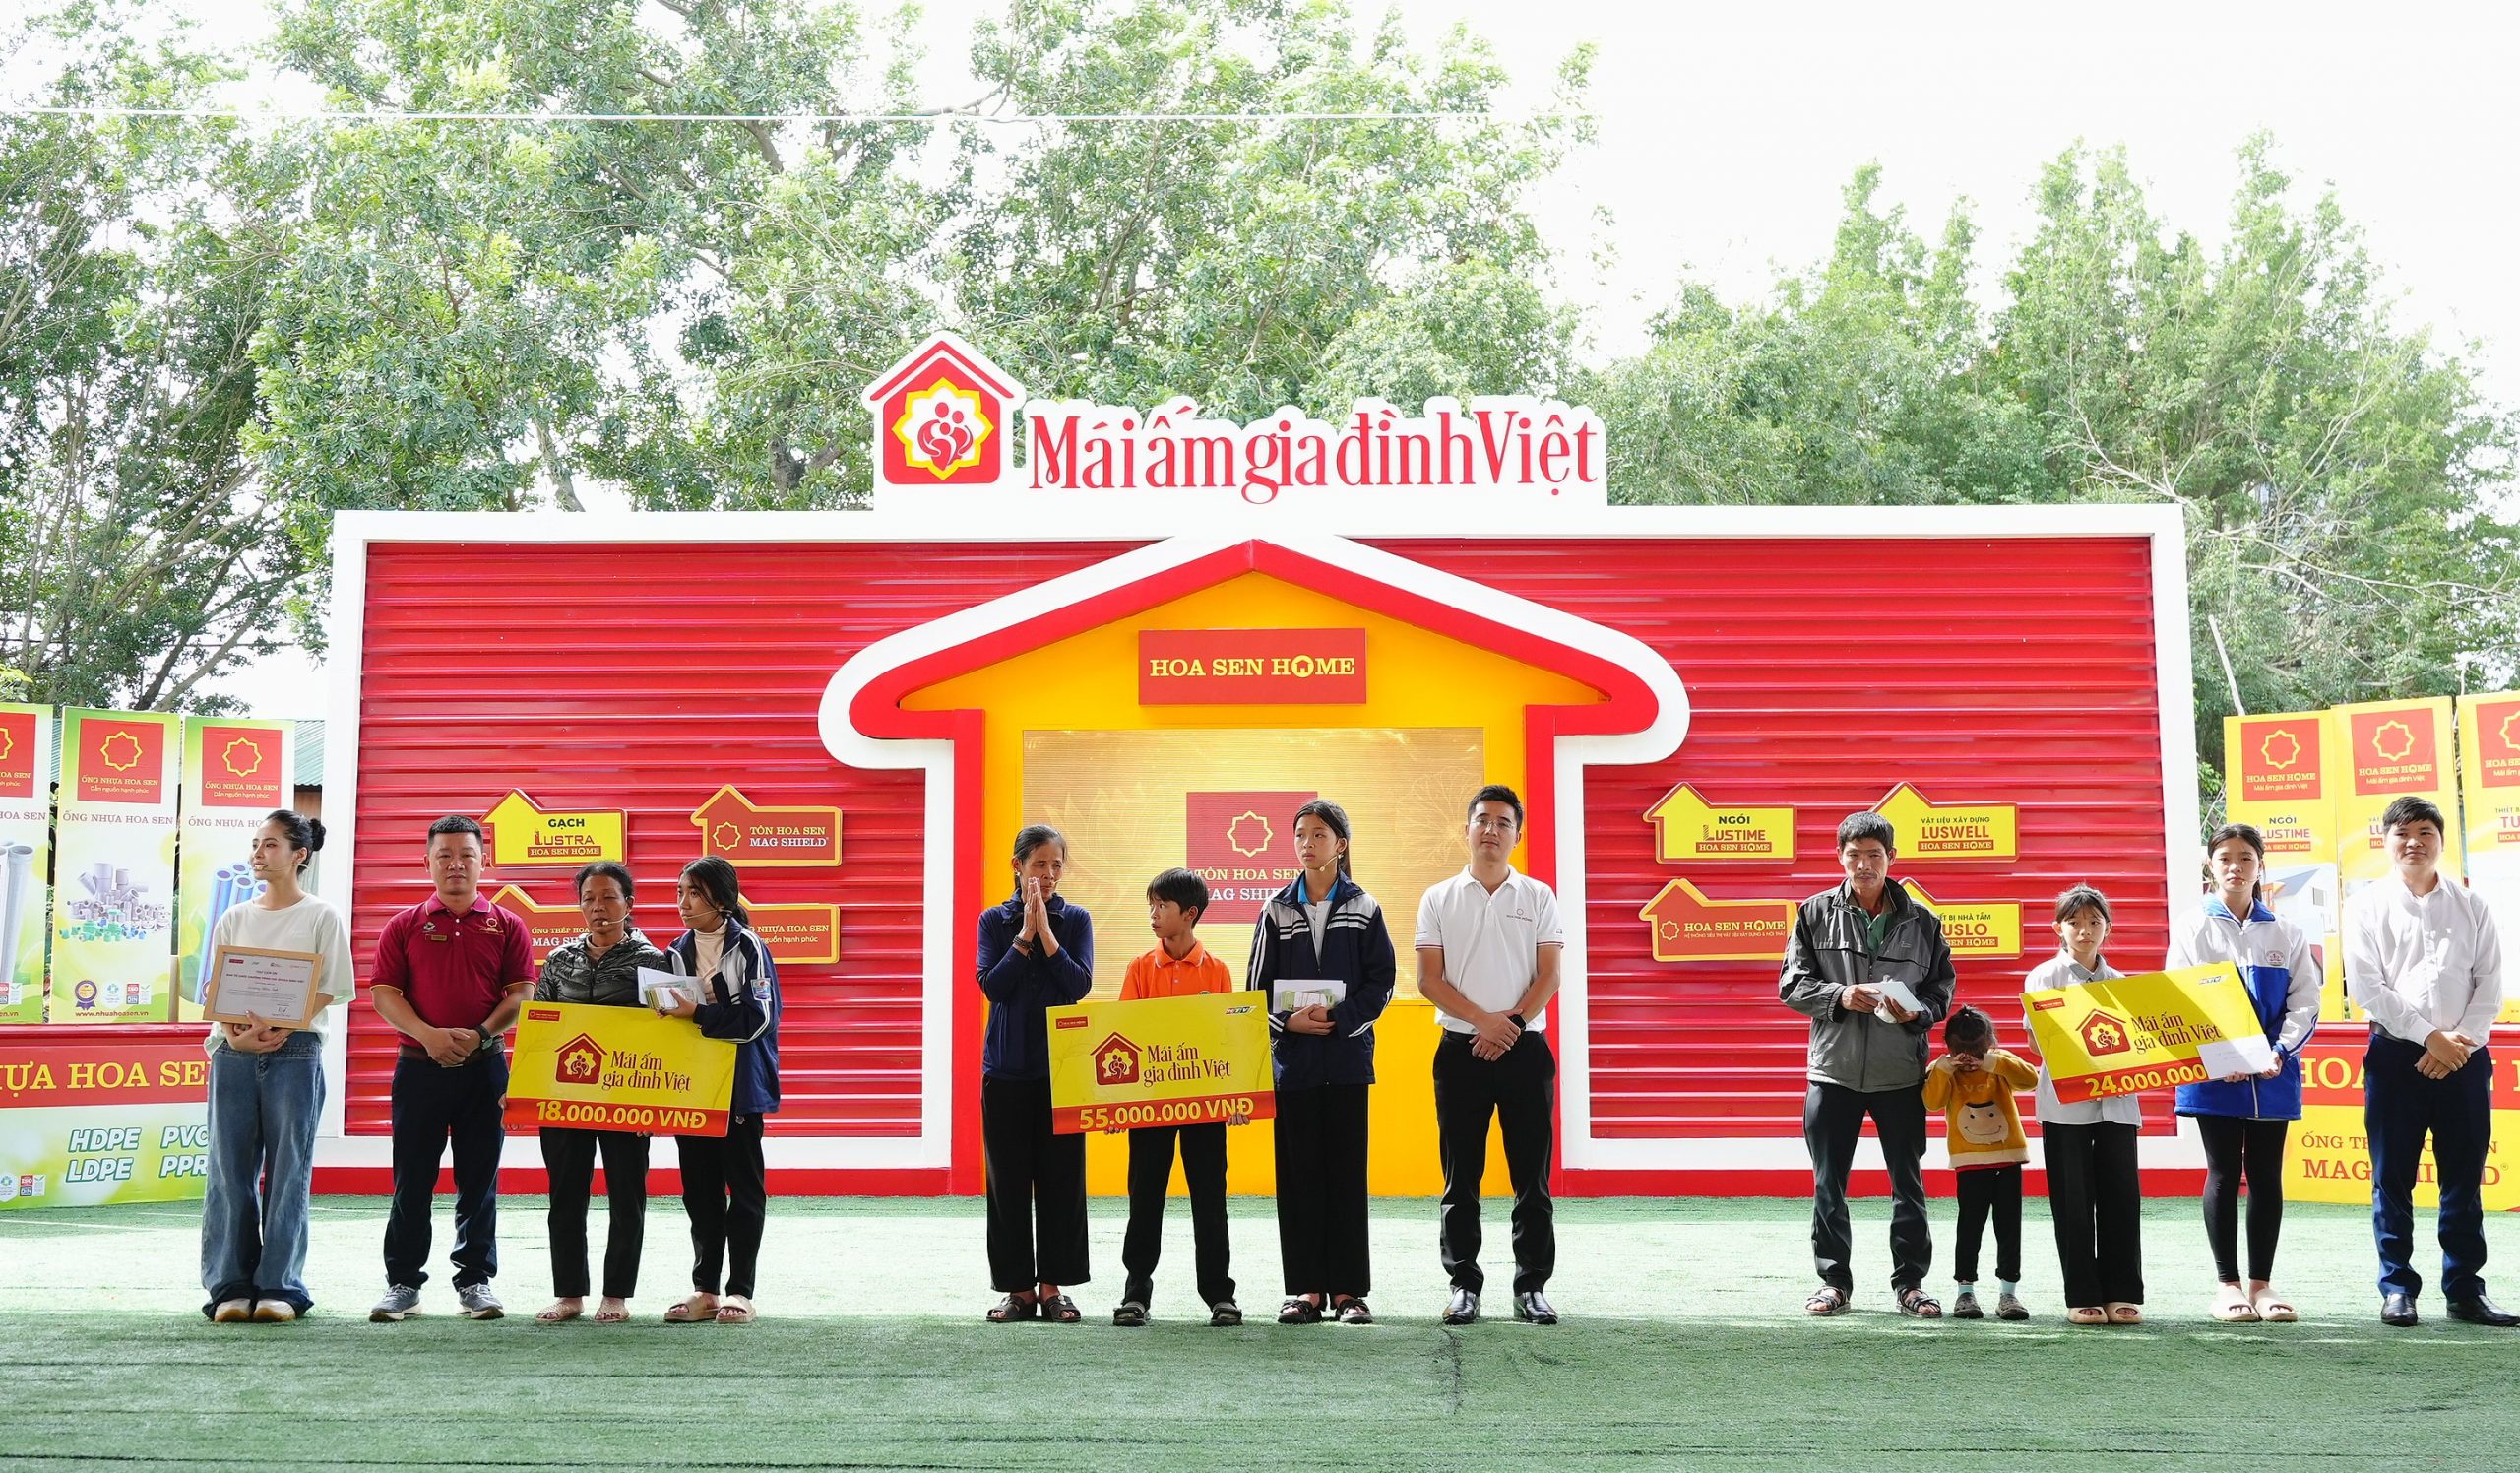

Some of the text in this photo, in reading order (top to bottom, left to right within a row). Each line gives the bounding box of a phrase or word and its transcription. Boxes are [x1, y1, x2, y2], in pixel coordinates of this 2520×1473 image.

[1029, 405, 1599, 504] Mái ấm gia đình Việt
[1150, 655, 1355, 678] HOA SEN HOME
[2379, 766, 2399, 775] SEN
[2401, 763, 2432, 774] HOME
[2485, 758, 2520, 768] HOA SE
[82, 774, 98, 784] ỐNG
[100, 776, 122, 786] NHỰA
[2287, 773, 2315, 782] HOME
[63, 809, 87, 821] ỐNG
[91, 812, 122, 824] NHỰA
[152, 816, 173, 825] SEN
[188, 816, 262, 829] ỐNG NHỰA HO
[1718, 814, 1750, 824] NGÓI
[548, 819, 585, 830] GẠCH
[750, 825, 825, 835] TÔN HOA SEN
[1703, 824, 1766, 841] LUSTIME
[1922, 825, 1989, 839] LUSWELL
[750, 837, 827, 847] MAG SHIELD
[1740, 843, 1770, 852] HOME
[1963, 841, 1992, 850] HOME
[1195, 866, 1228, 880] TÔN
[1232, 869, 1268, 880] HOA
[1209, 888, 1235, 901] AG
[1958, 912, 1974, 921] NHÀ
[532, 926, 549, 934] ỐNG
[550, 926, 571, 934] THÉP
[758, 925, 785, 934] NHỰA
[1684, 920, 1786, 931] HOA SEN HOME
[1942, 923, 1987, 936] USLO
[532, 937, 560, 947] MAG
[801, 935, 818, 944] phúc
[1966, 938, 1995, 947] HOME
[2131, 1011, 2184, 1033] Mái ấm
[2133, 1023, 2221, 1055] gia đình Việt
[1148, 1042, 1198, 1063] Mái ấm
[611, 1051, 662, 1070] Mái ấm
[0, 1061, 210, 1097] ỰA HOA SE
[1144, 1059, 1230, 1088] gia đình Việt
[2085, 1063, 2207, 1097] 24.000.000
[601, 1070, 691, 1093] gia đình Việt
[536, 1100, 707, 1129] 18.000.000 VNĐ
[1079, 1097, 1254, 1130] 55.000.000 VNĐ
[68, 1125, 208, 1152] HDPE PVC
[2301, 1130, 2344, 1149] ỐNG
[66, 1154, 208, 1182] LDPE PPR
[2302, 1158, 2371, 1180] MAG
